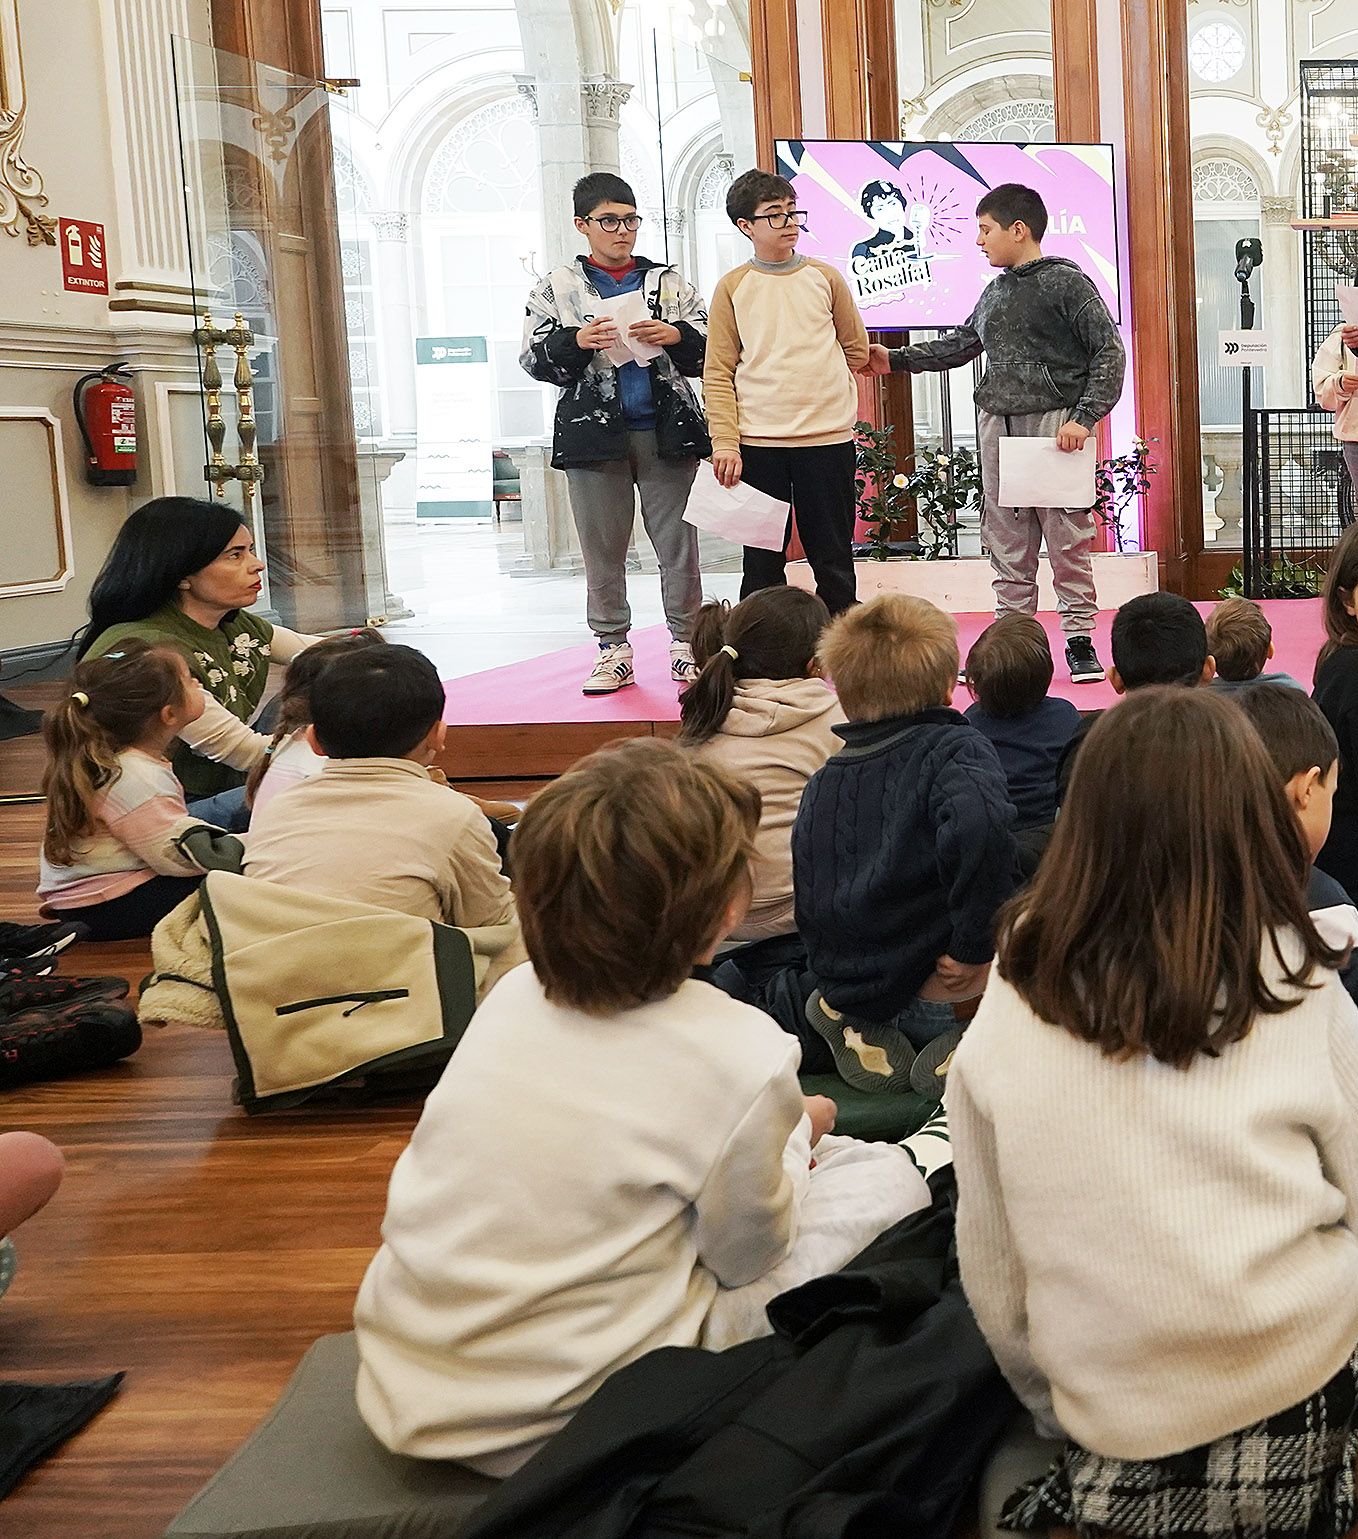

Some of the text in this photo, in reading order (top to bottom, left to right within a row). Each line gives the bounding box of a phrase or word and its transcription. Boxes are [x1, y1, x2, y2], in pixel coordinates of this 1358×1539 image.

[852, 251, 906, 276] Canta
[67, 276, 106, 288] EXTINTOR
[857, 261, 931, 297] Rosalía!
